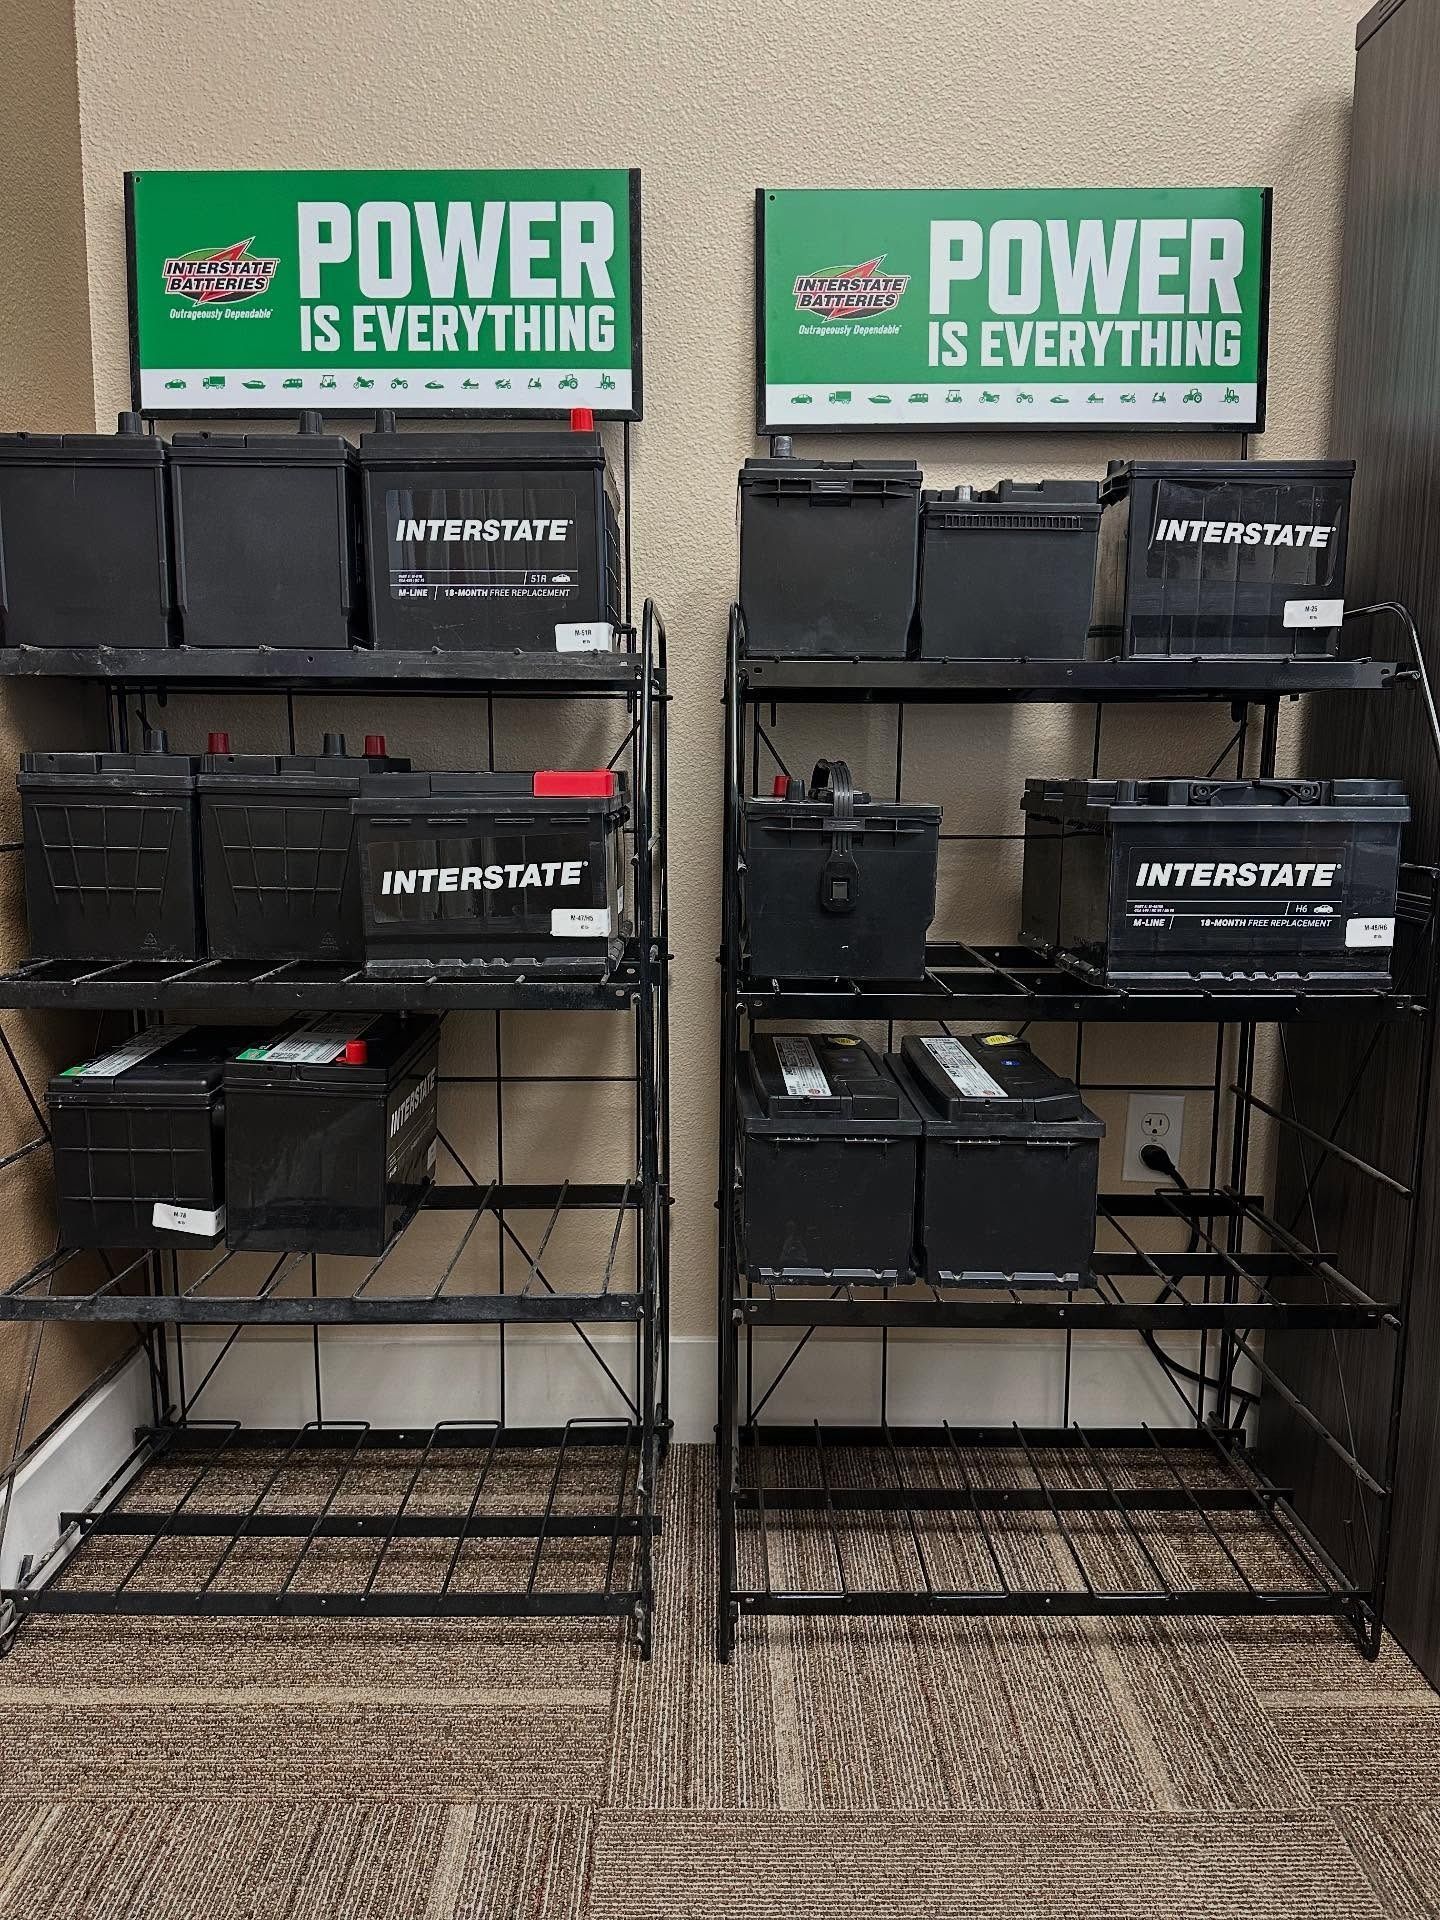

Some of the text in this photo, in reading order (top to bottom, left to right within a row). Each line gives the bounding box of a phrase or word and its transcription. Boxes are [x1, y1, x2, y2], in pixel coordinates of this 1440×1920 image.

[297, 201, 615, 298] POWER
[166, 262, 274, 275] INTERSTATE
[929, 219, 1245, 315] POWER
[170, 277, 266, 290] BATTERIES
[797, 279, 904, 291] INTERSTATE
[800, 294, 896, 307] BATTERIES
[169, 308, 272, 320] Outrageously Dependable
[300, 305, 615, 352] IS EVERYTHING
[798, 325, 901, 337] Outrageously Dependable
[928, 321, 1241, 367] IS EVERYTHING
[395, 519, 573, 542] INTERSTATE
[1155, 519, 1337, 548] INTERSTATE
[530, 574, 547, 583] 51R
[398, 588, 428, 597] M-LINE
[444, 588, 570, 597] 18-MONTH FREE REPLACEMENT
[381, 860, 588, 895] INTERSTATE
[1135, 863, 1342, 886] INTERSTATE
[1295, 904, 1308, 913] H6
[1132, 919, 1166, 927] M-LINE
[1200, 919, 1332, 928] 18-MONTH FREE REPLACEMENT
[390, 1067, 436, 1138] INTERSTATE
